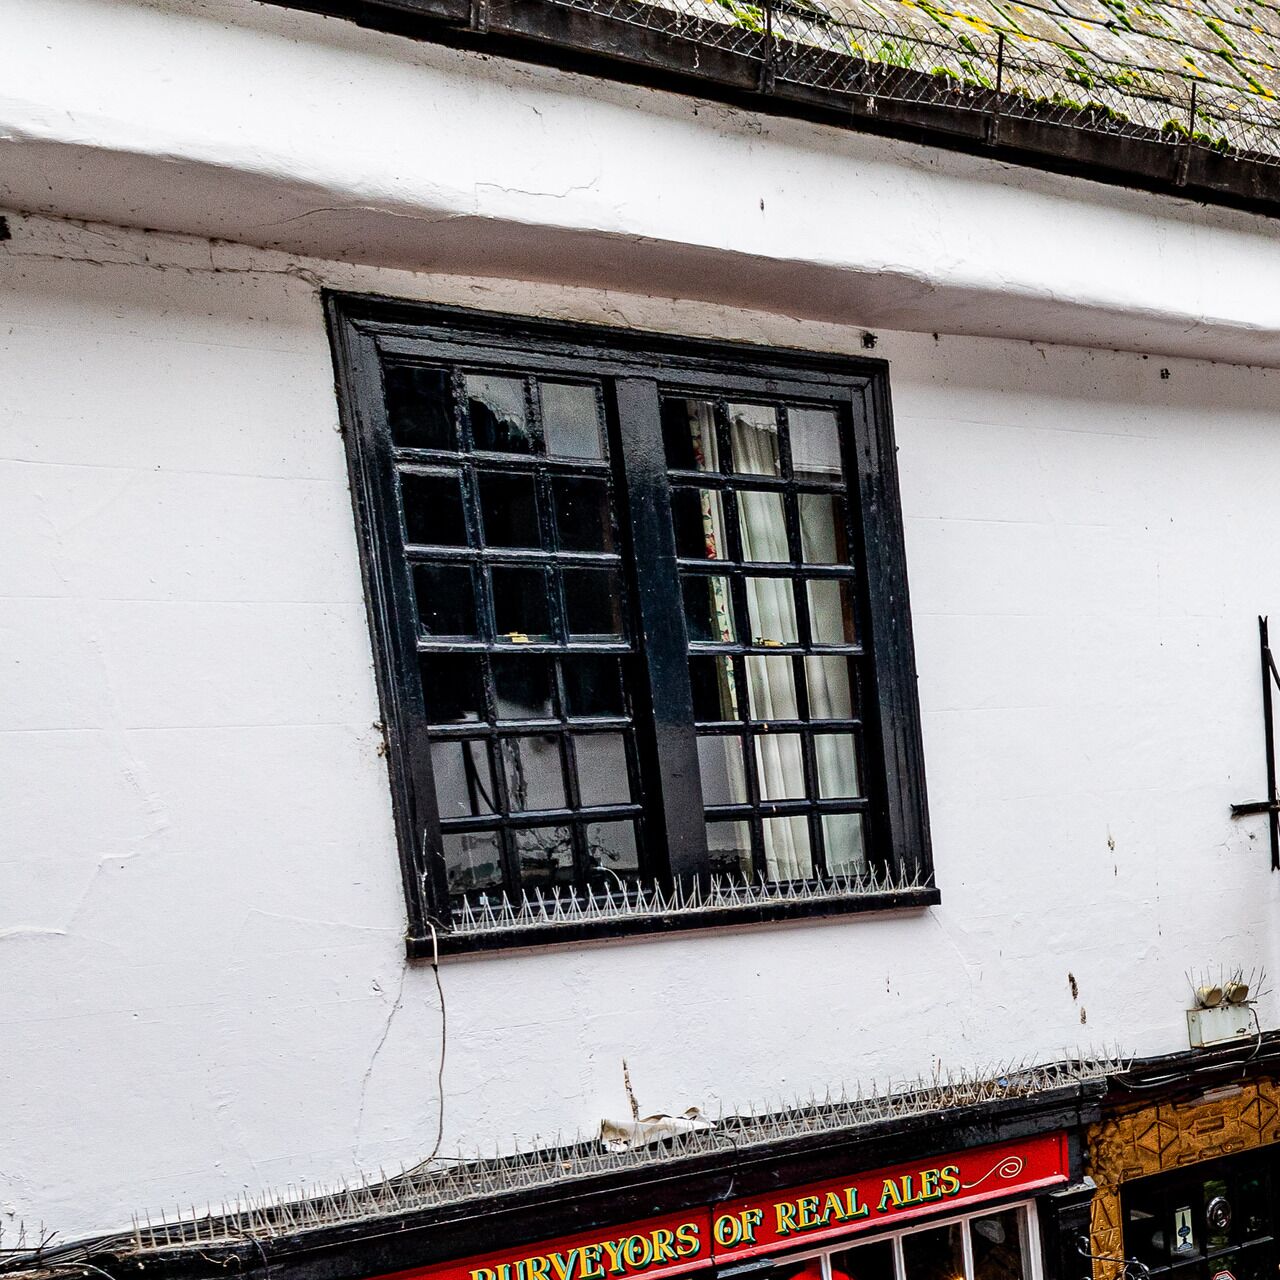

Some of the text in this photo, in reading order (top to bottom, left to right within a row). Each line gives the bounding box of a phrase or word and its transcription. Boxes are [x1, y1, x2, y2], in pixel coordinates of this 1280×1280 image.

[714, 1207, 761, 1249] OF
[776, 1186, 868, 1236] REAL
[876, 1164, 961, 1213] ALES
